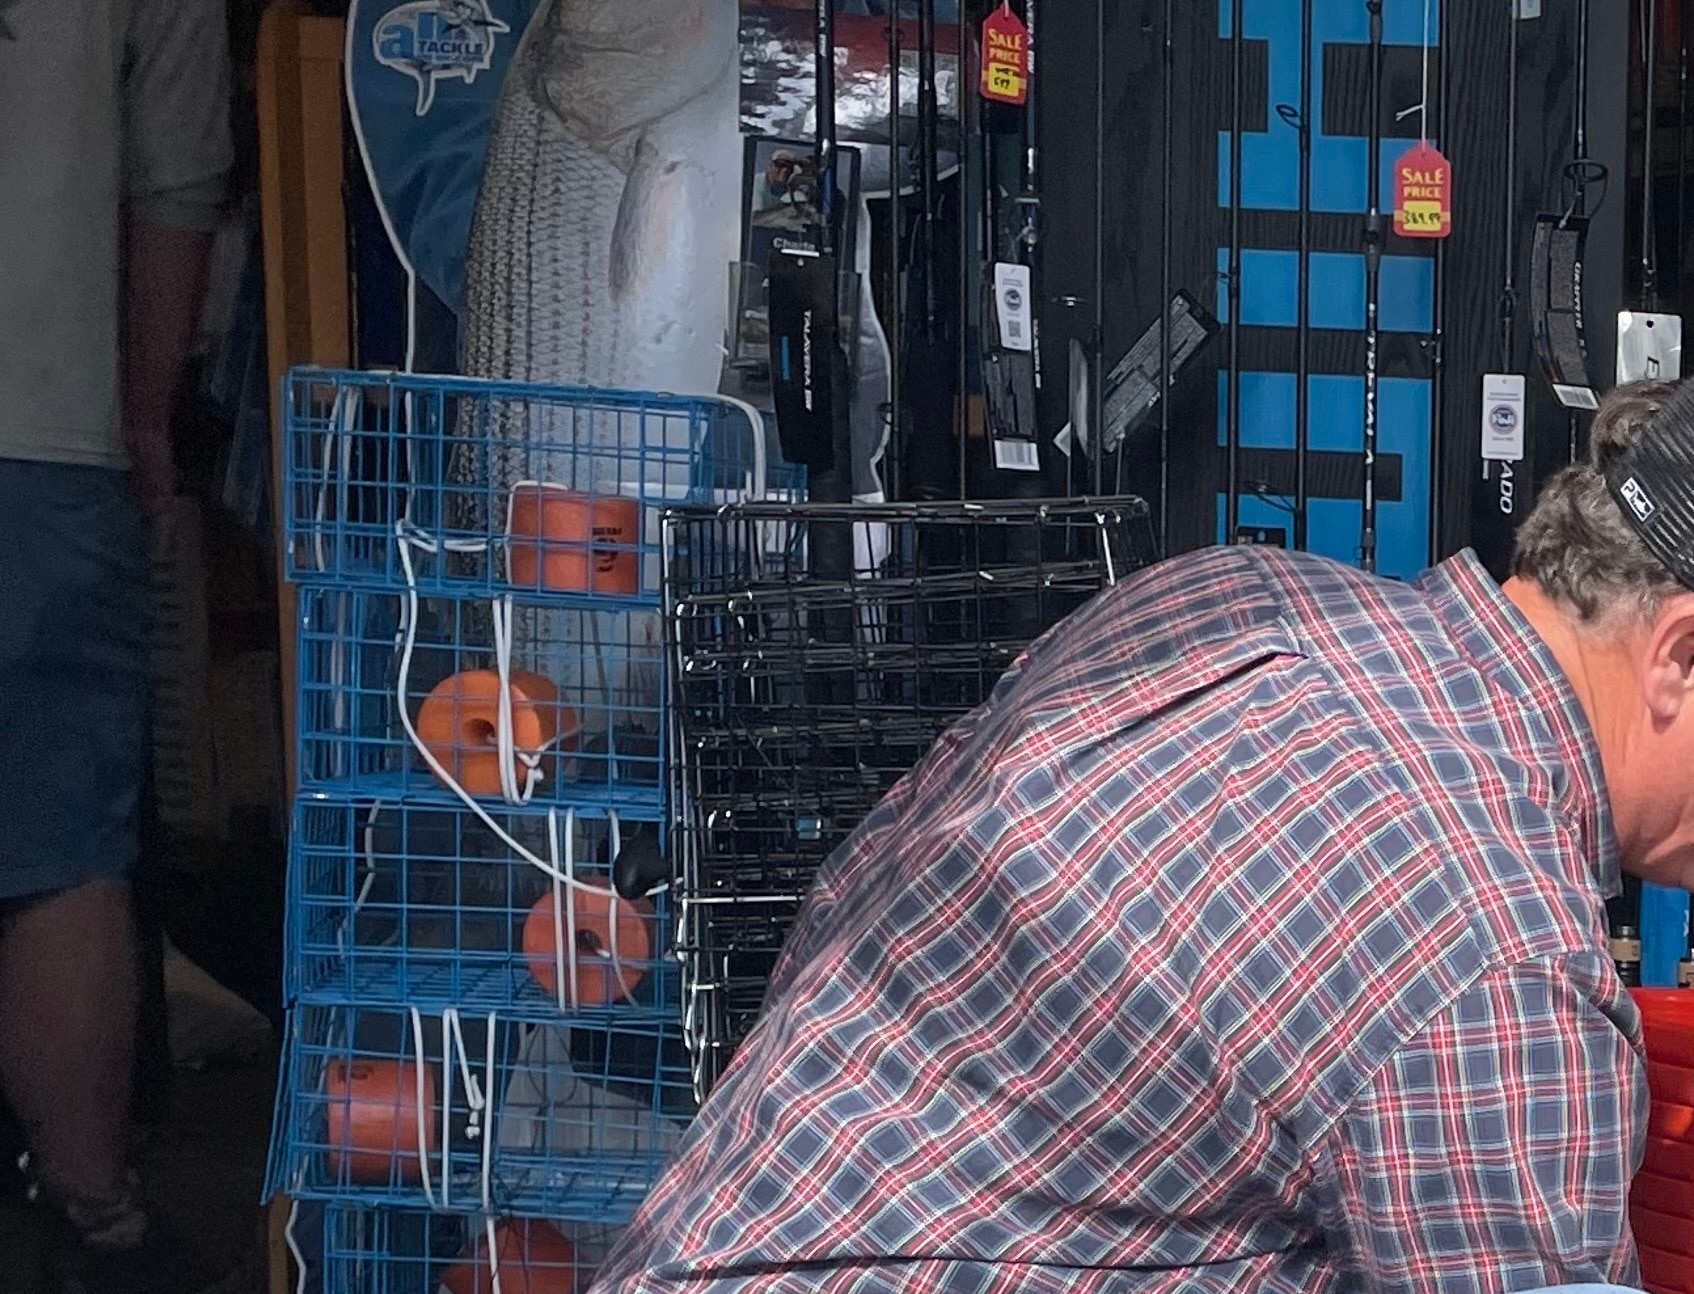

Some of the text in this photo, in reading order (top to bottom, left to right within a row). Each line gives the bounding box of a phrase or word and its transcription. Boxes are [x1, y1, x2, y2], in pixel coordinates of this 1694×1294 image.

[988, 28, 1022, 50] SALE
[417, 41, 485, 55] TACKLE
[1402, 167, 1444, 184] SALE
[1403, 185, 1442, 199] PRICE
[1500, 459, 1513, 514] ADO
